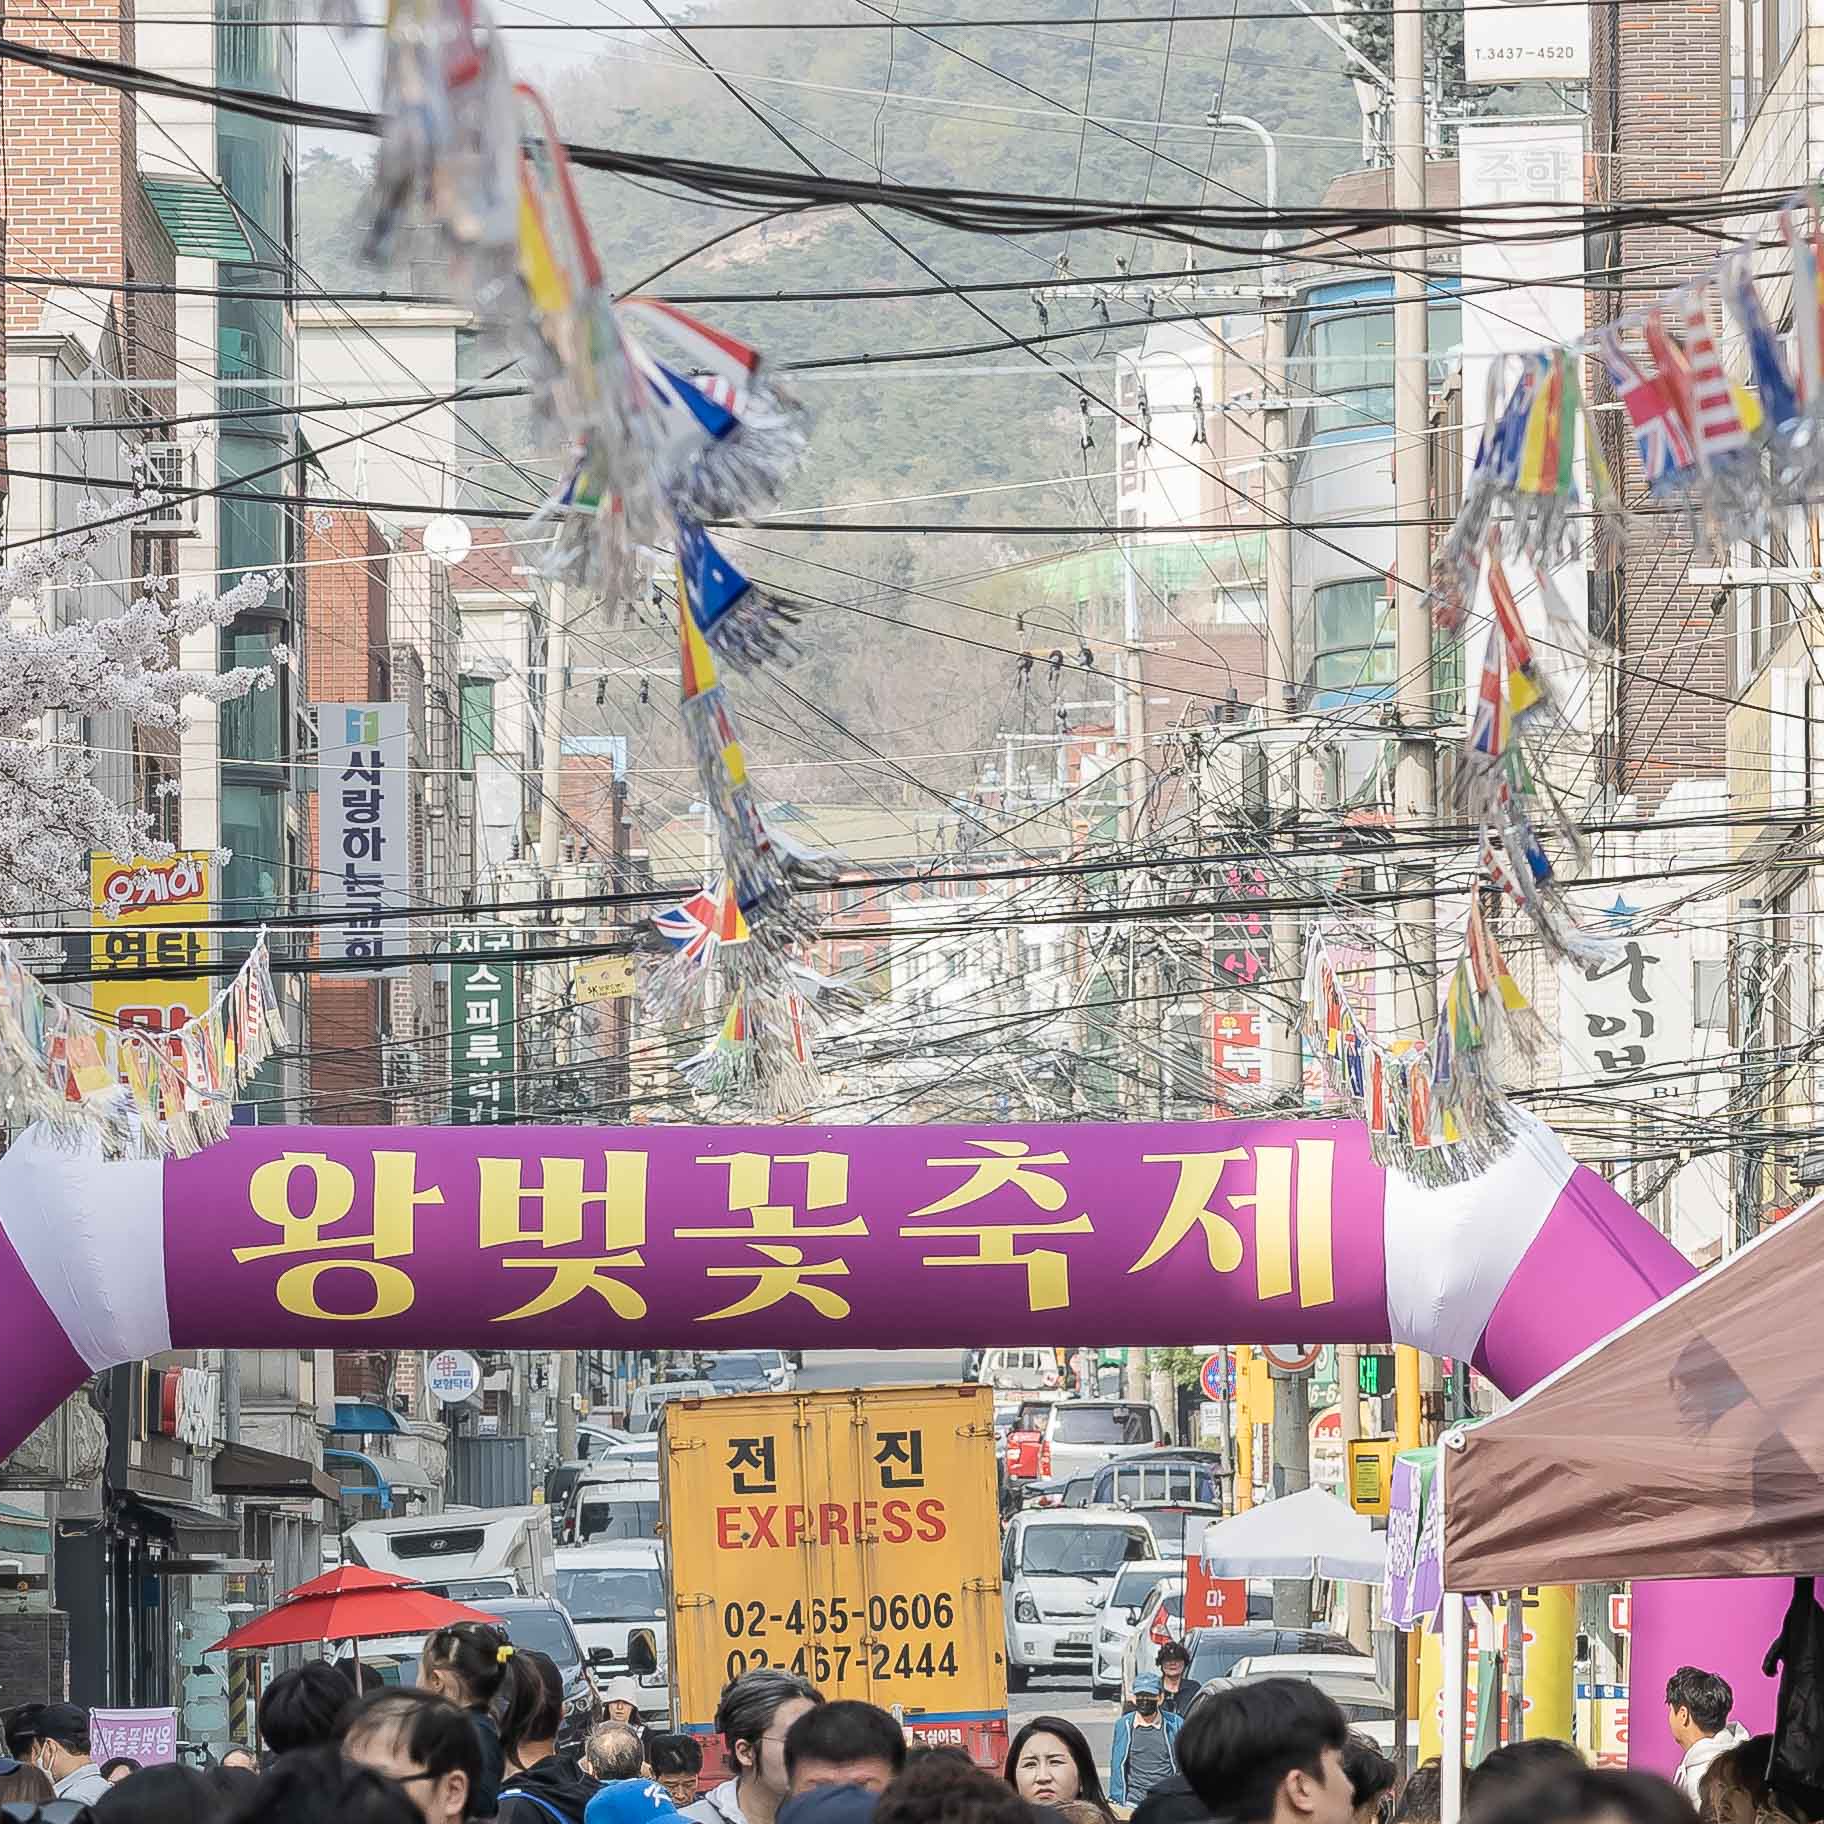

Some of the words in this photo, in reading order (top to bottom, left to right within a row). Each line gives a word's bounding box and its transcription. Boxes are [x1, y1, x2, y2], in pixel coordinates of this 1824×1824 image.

[230, 1138, 1337, 1322] 왕벚꽃축제
[715, 1498, 947, 1550] EXPRESS
[723, 1591, 955, 1638] 02-465-0606
[725, 1640, 959, 1683] 02-467-2444
